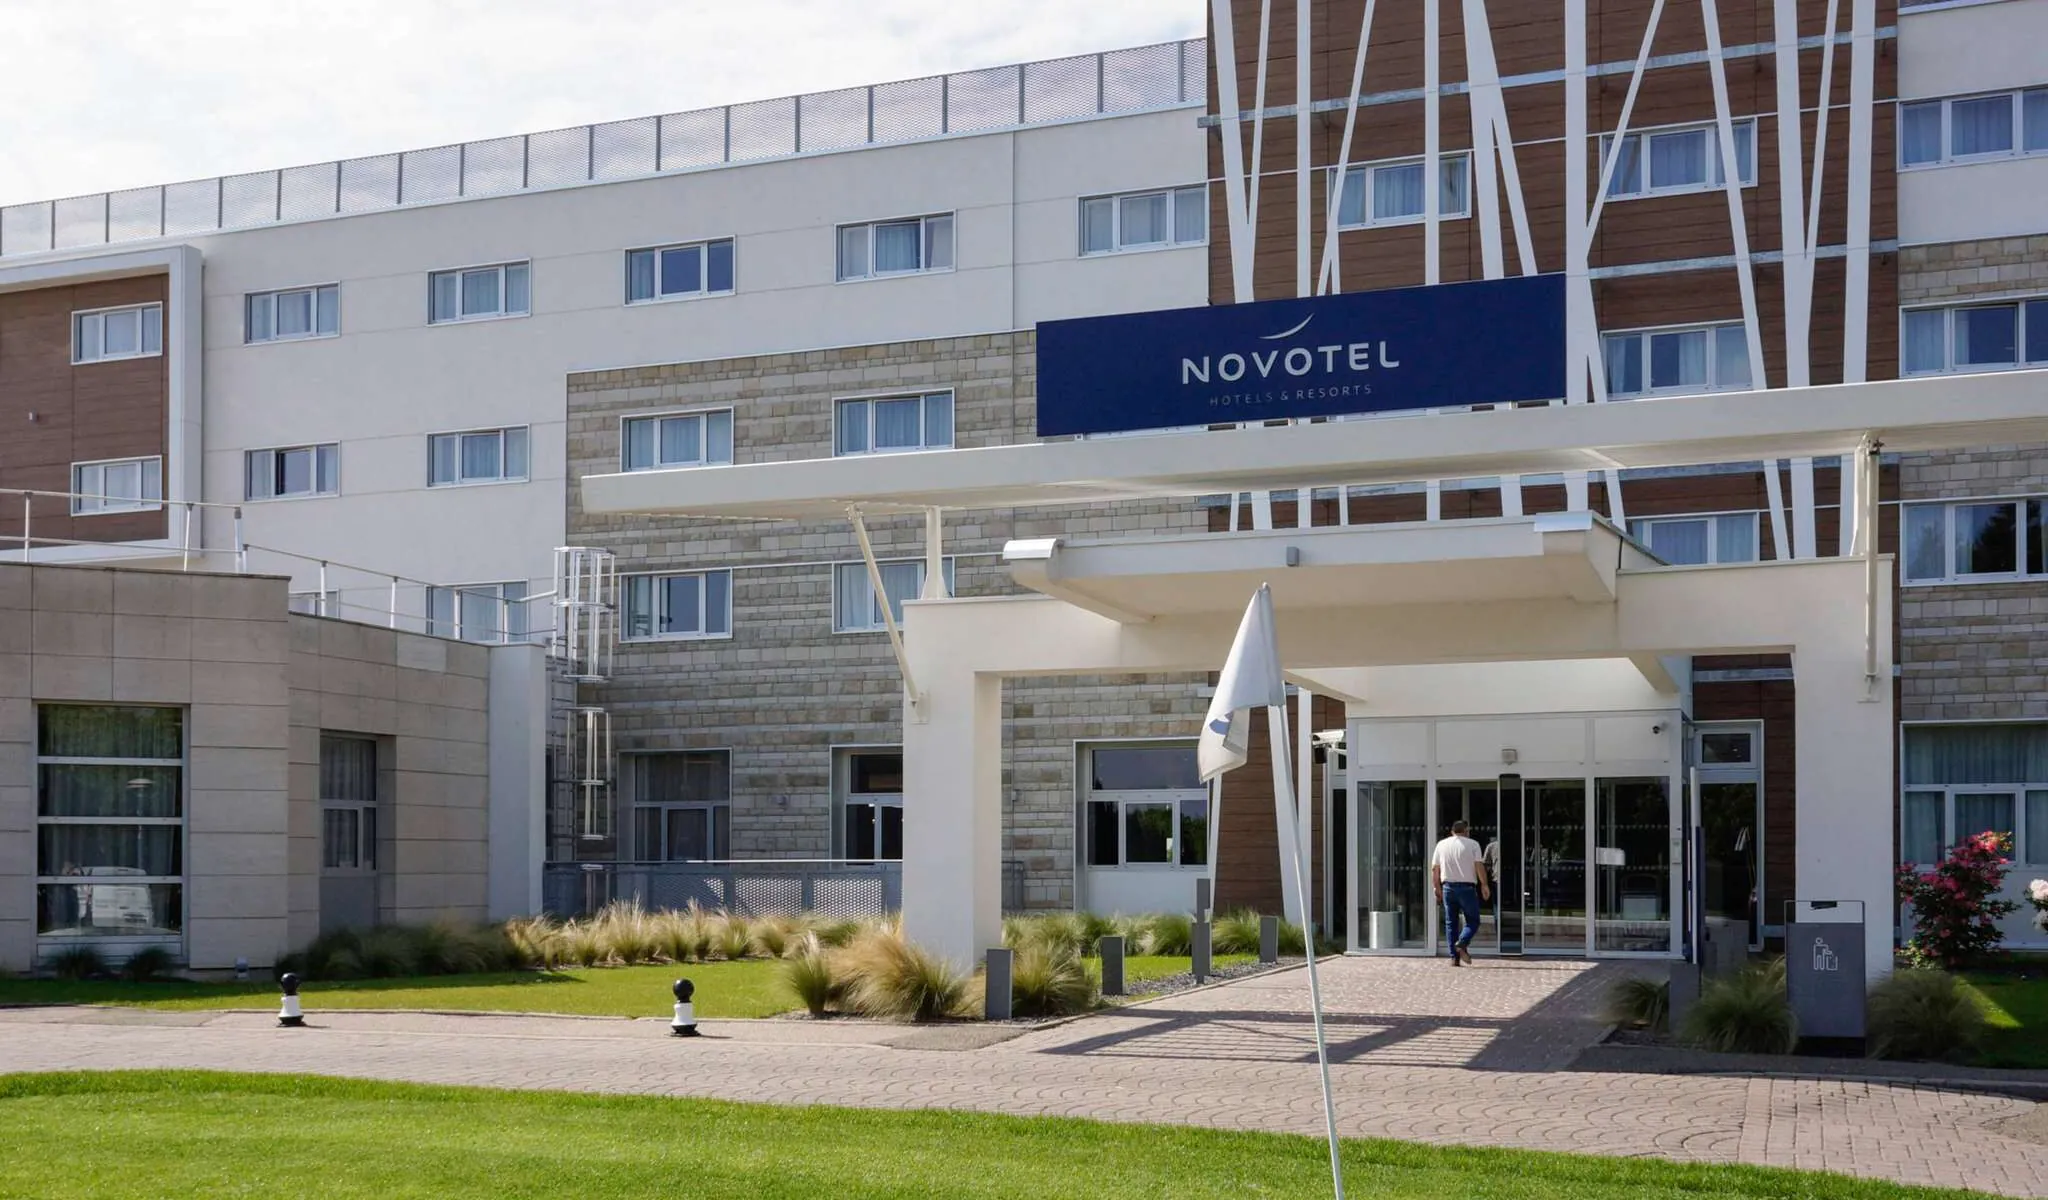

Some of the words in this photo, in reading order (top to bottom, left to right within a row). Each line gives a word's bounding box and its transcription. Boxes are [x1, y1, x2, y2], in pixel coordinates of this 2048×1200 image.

[1181, 340, 1400, 385] NOVOTEL
[1209, 392, 1273, 406] HOTELS
[1280, 391, 1289, 401] &
[1296, 383, 1373, 400] RESORTS
